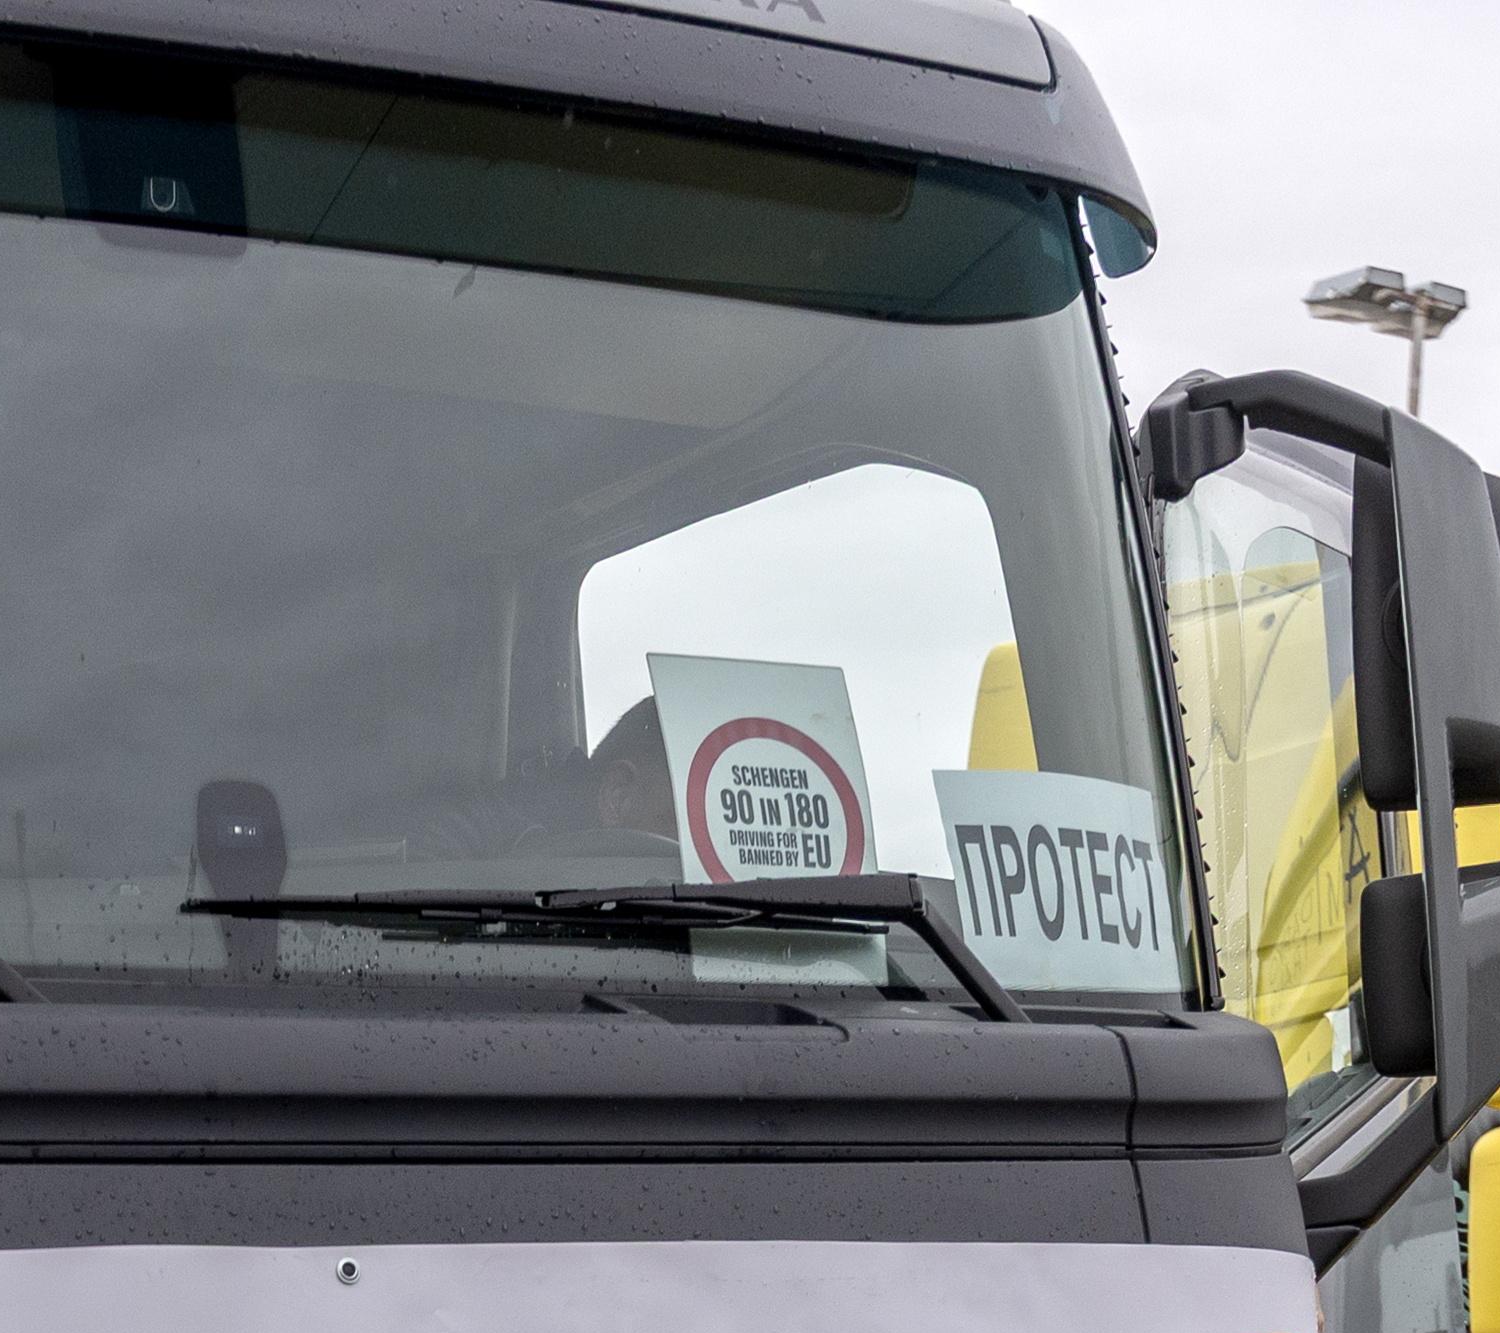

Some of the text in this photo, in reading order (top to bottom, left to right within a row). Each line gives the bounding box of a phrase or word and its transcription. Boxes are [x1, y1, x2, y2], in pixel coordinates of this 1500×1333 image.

[732, 765, 808, 790] SCHENGEN
[721, 788, 829, 829] 90 IN 180
[730, 829, 797, 849] DRIVING FOR
[802, 834, 831, 869] EU
[739, 850, 799, 867] BANNED BY
[953, 823, 1157, 951] ПРОТЕСТ
